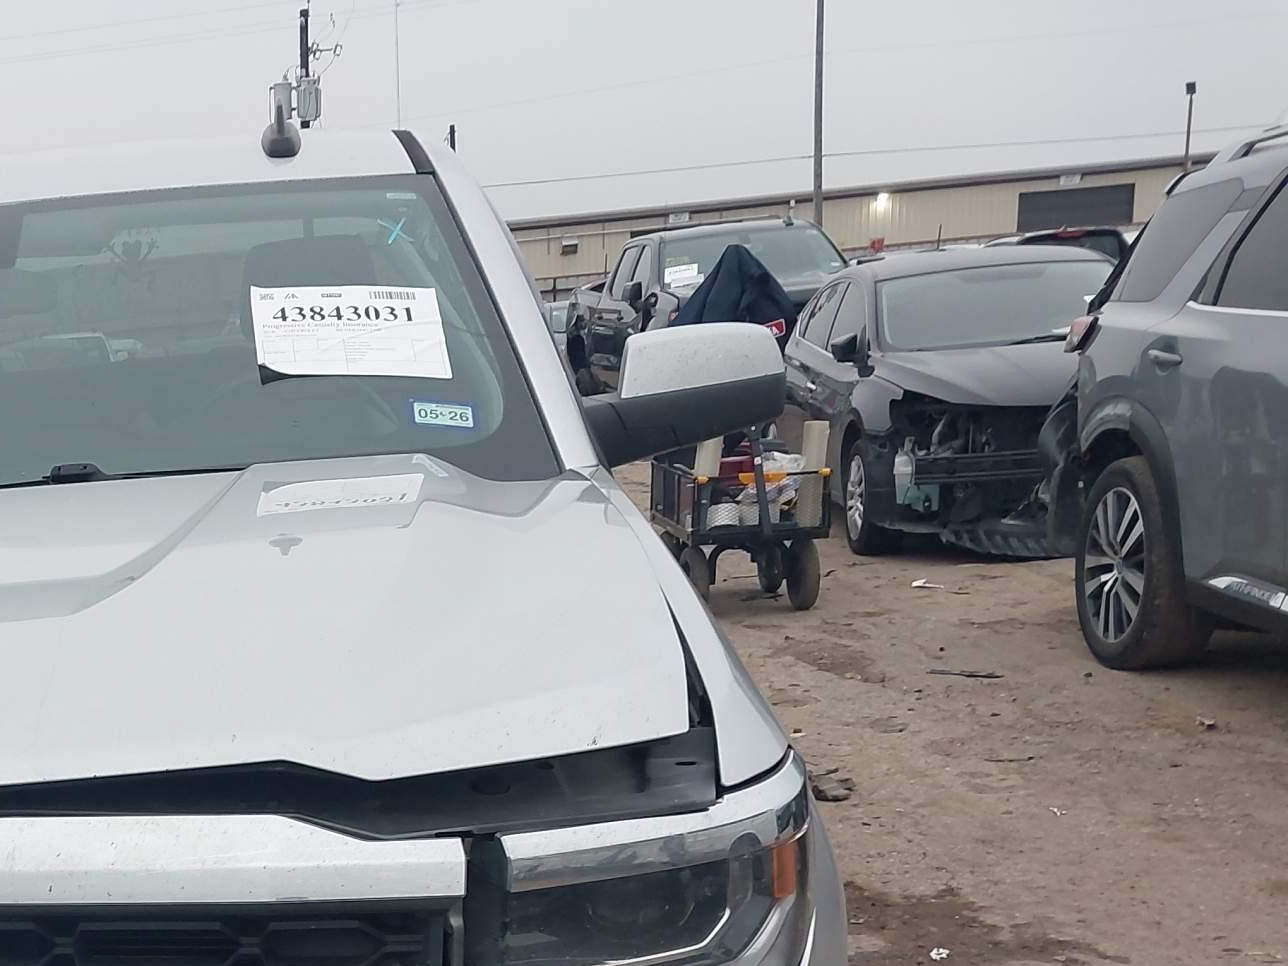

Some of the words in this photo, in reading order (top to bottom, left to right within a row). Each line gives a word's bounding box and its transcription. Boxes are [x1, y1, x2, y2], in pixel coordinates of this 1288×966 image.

[272, 304, 414, 322] 43843031
[418, 408, 440, 420] 05
[448, 410, 470, 422] 26
